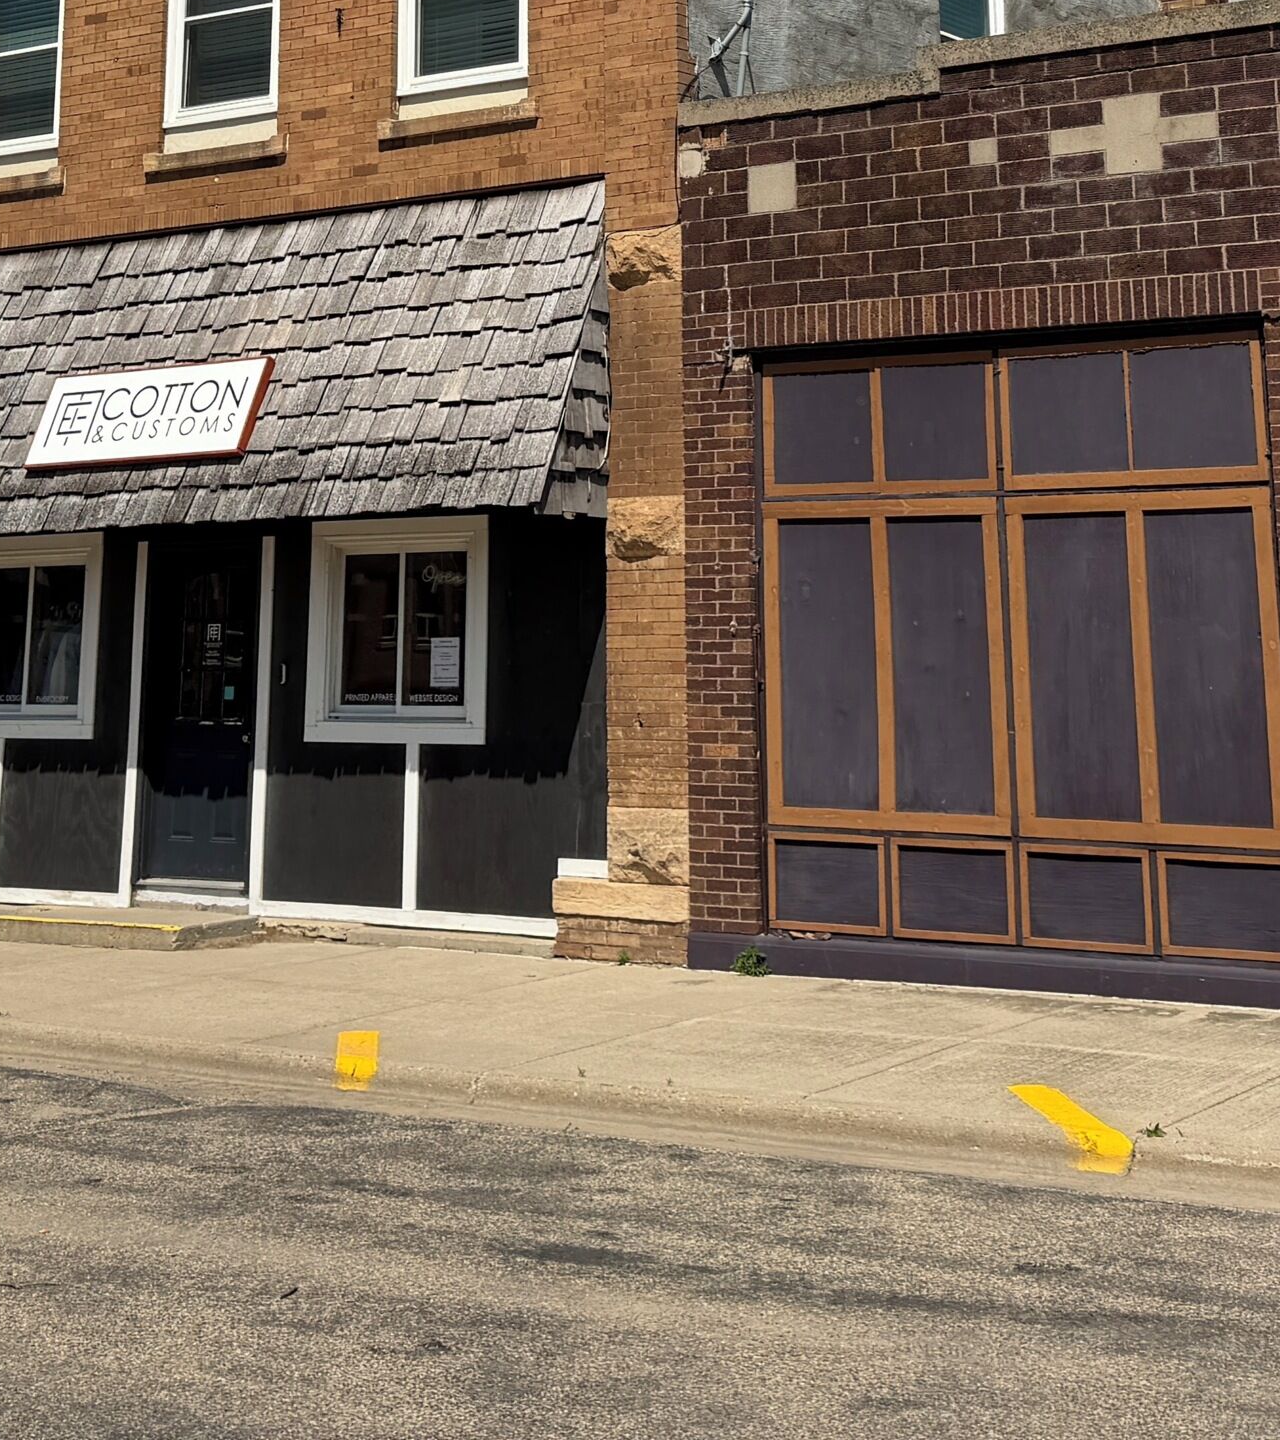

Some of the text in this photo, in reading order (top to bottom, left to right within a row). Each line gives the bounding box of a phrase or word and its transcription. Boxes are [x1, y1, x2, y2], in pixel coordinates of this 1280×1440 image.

[102, 376, 249, 420] COTTON
[91, 425, 104, 443] &
[111, 412, 236, 442] CUSTOMS
[344, 693, 369, 702] PRINTED
[409, 693, 459, 703] WEBSITE DESIGN
